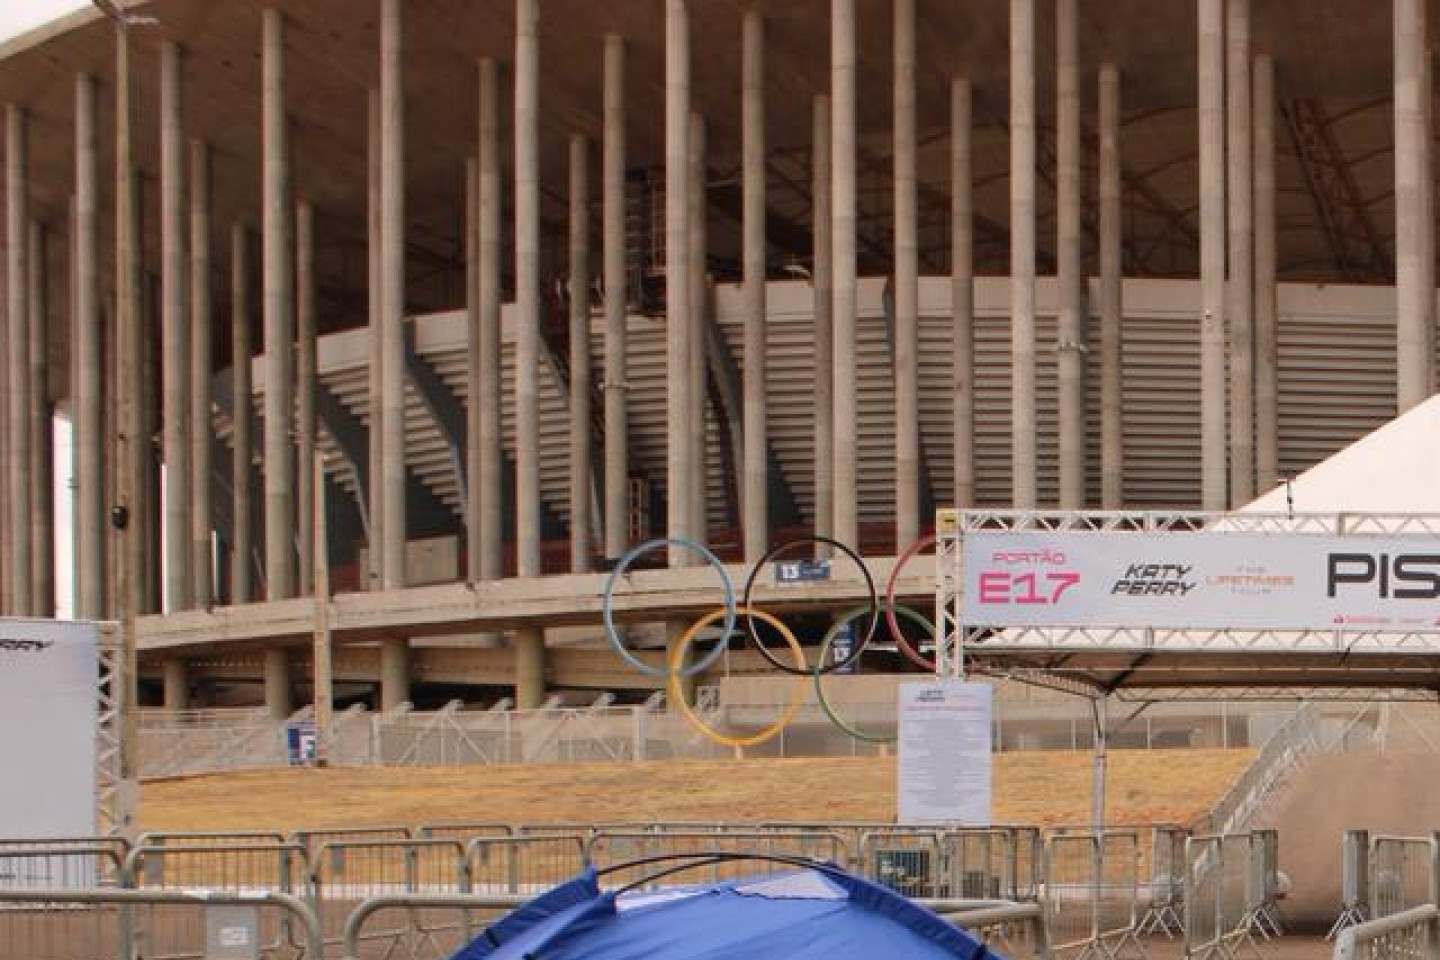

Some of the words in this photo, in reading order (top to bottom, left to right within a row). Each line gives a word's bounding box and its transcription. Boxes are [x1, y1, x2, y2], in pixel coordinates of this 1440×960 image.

[991, 549, 1064, 565] PORTÃO
[1125, 563, 1192, 579] KATY
[979, 572, 1081, 604] E17
[1111, 579, 1197, 596] PERRY
